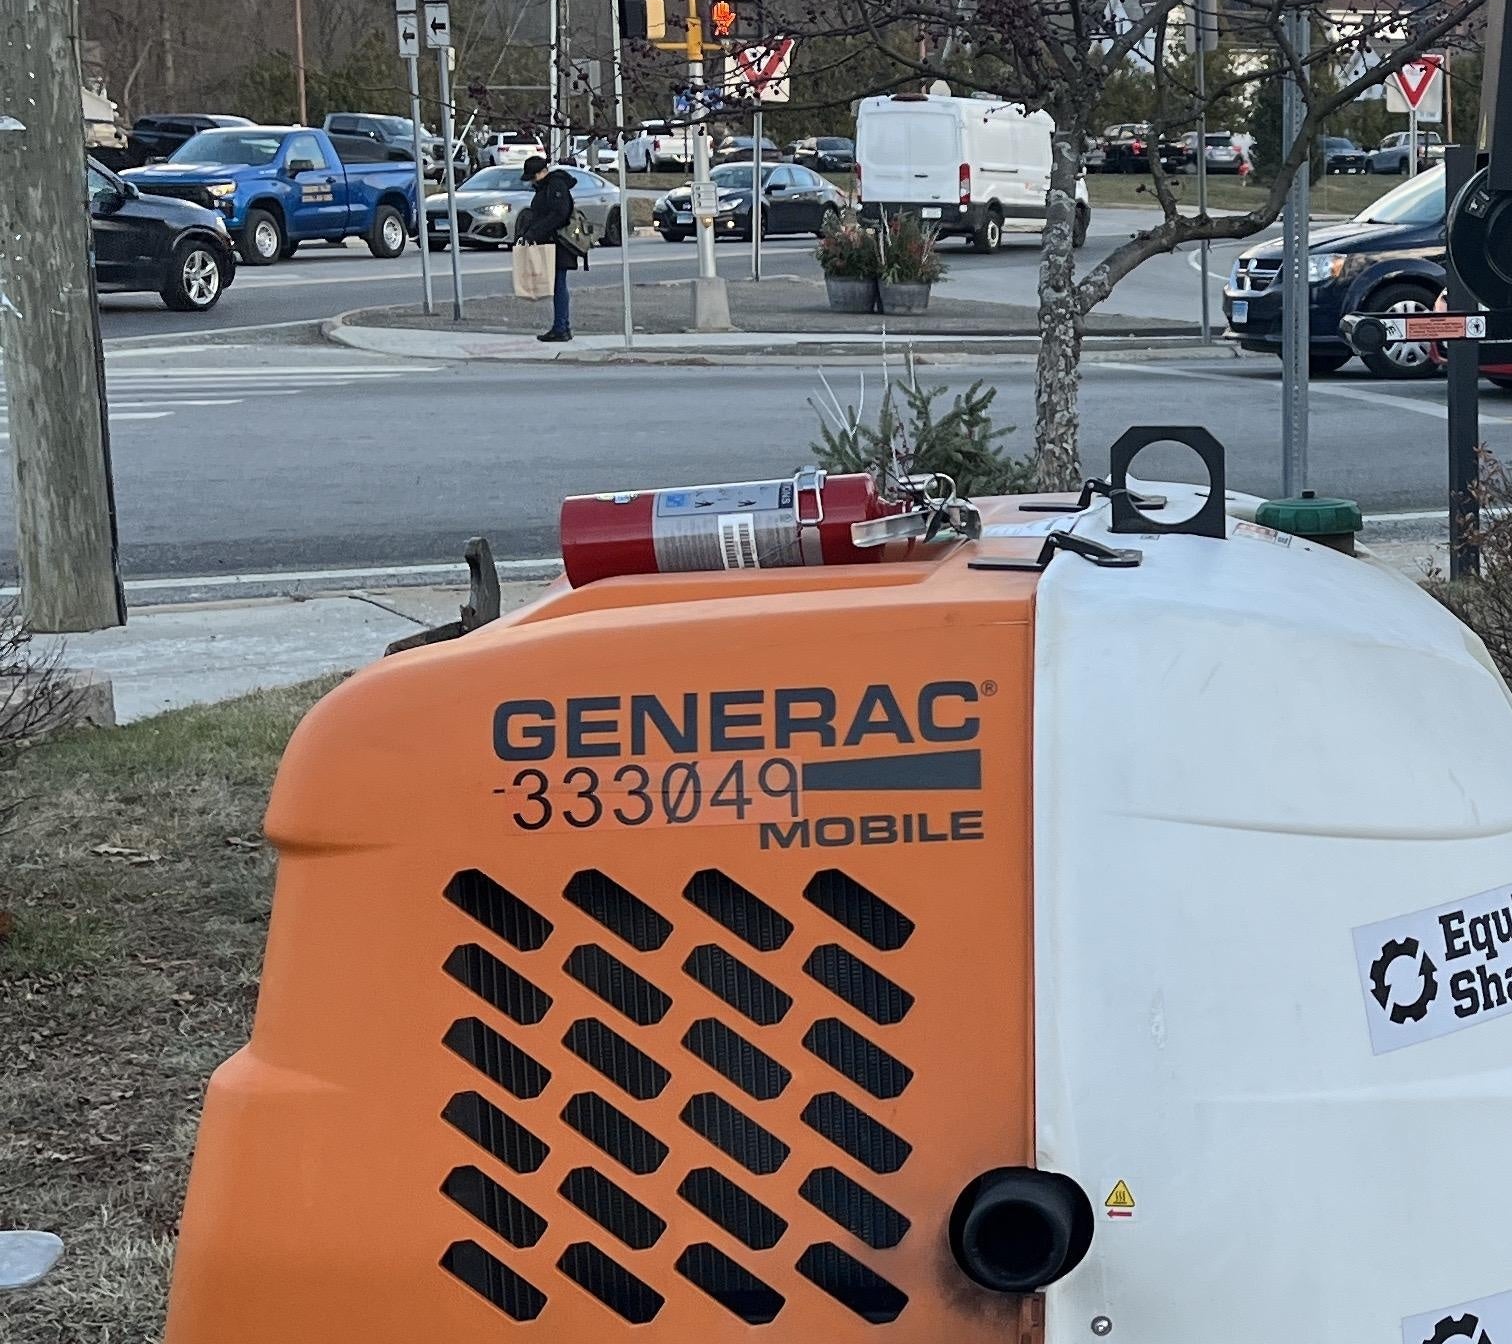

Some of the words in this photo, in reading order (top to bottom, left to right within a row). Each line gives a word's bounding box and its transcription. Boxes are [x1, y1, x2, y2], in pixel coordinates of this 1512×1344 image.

[492, 680, 982, 761] GENERAC
[512, 756, 800, 831] 333049
[758, 810, 985, 851] MOBILE
